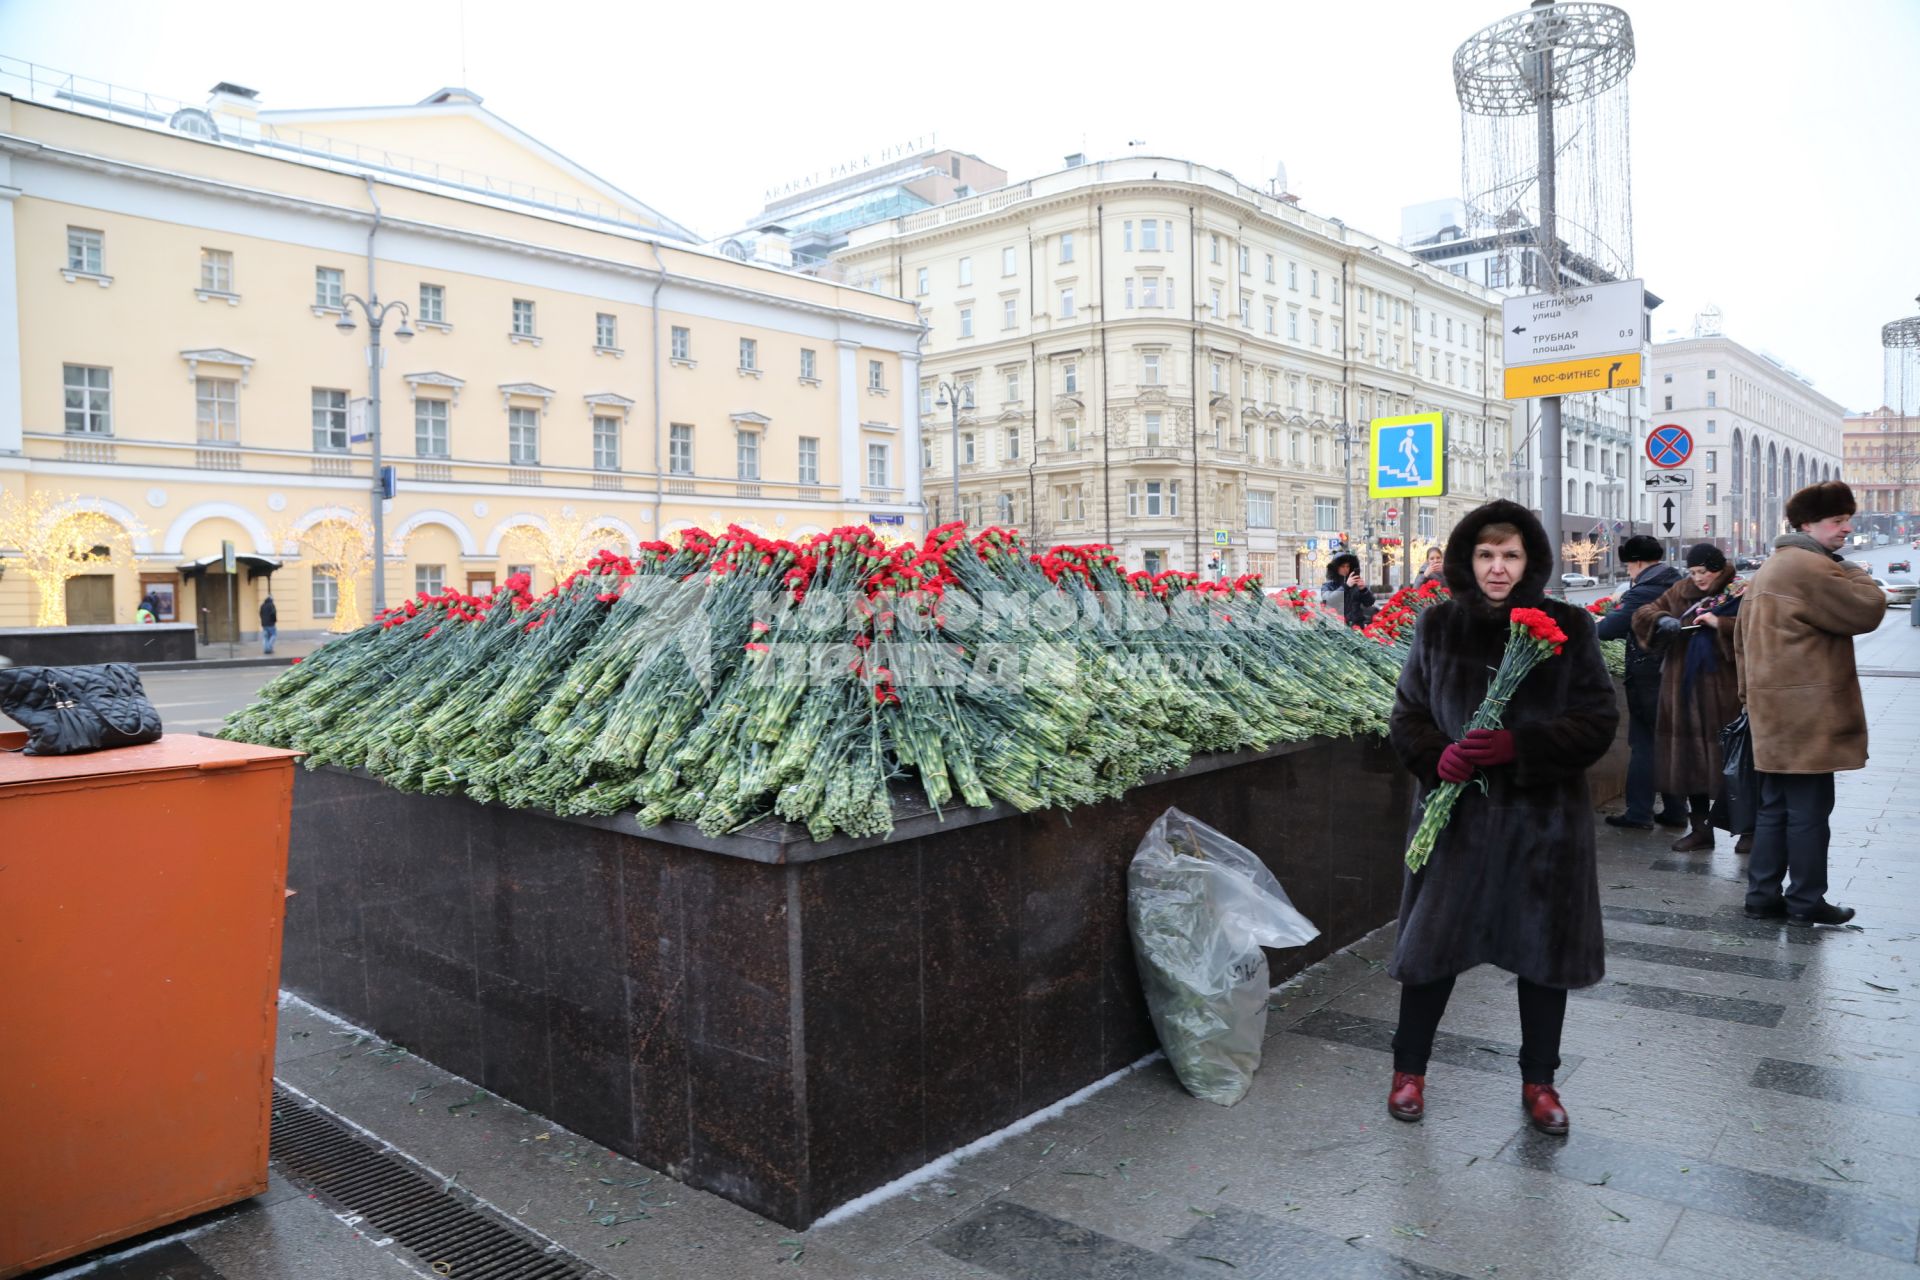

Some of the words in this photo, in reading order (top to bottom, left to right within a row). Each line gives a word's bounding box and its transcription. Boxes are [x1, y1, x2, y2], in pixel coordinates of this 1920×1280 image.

[764, 171, 821, 199] ARARAT
[830, 154, 871, 179] PARK
[881, 132, 937, 160] HYATT
[1532, 293, 1593, 310] НЕГЛИАЯ
[1532, 311, 1561, 322] улица
[1533, 330, 1578, 344] ТРУБНАЯ
[1532, 343, 1576, 355] площадь
[1533, 368, 1601, 384] МОС-ФИТНЕС
[1616, 378, 1630, 386] 200
